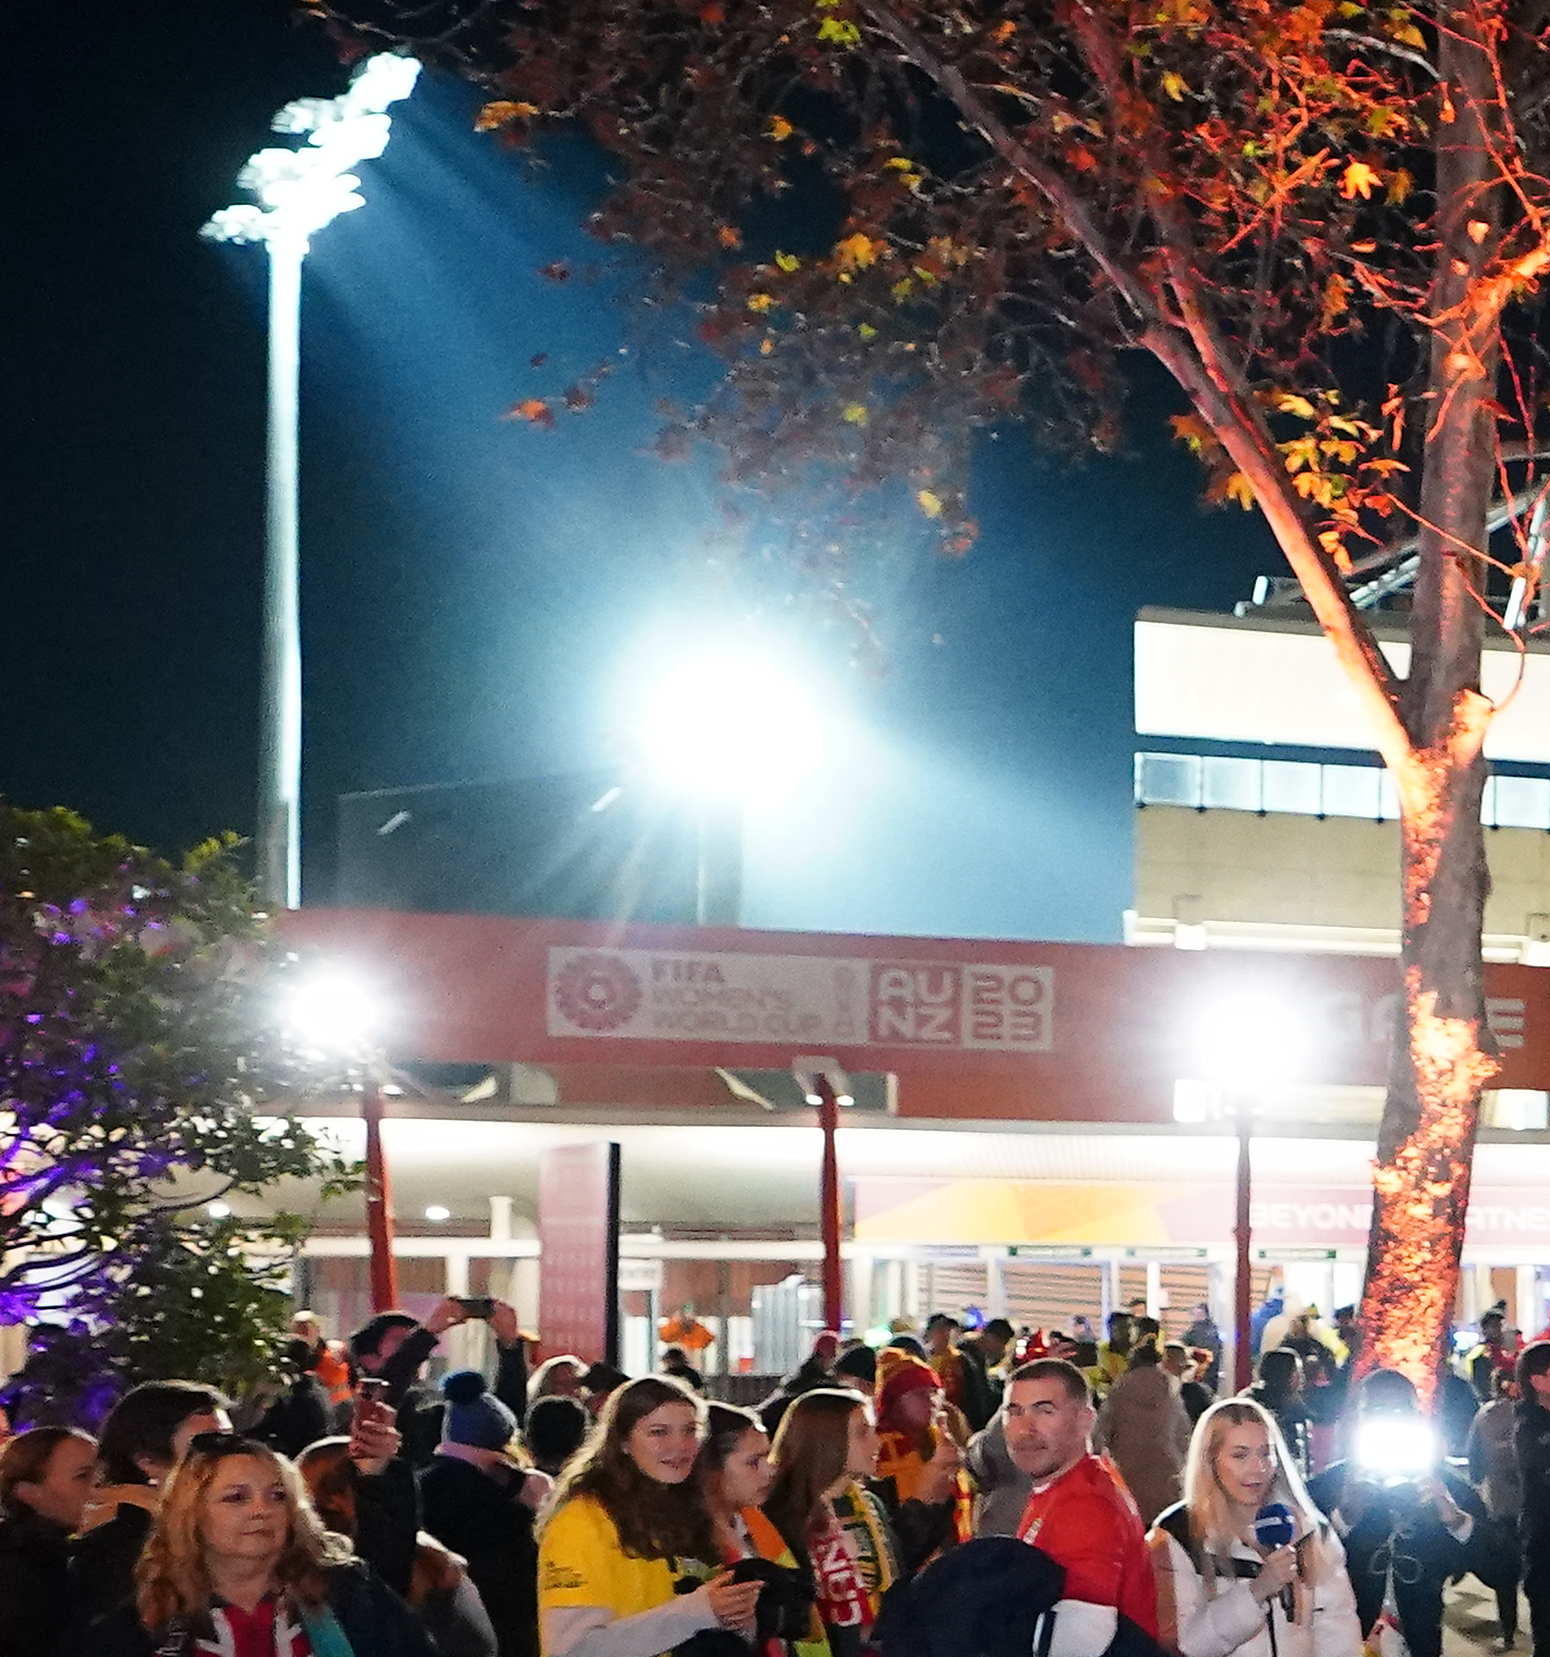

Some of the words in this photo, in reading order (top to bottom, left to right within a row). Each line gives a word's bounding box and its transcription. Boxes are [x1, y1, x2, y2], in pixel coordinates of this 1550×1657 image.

[651, 957, 726, 983] FIFA
[877, 968, 951, 1003] AU
[972, 973, 1044, 1006] 20
[876, 1005, 952, 1040] NZ
[971, 1009, 1044, 1041] 23
